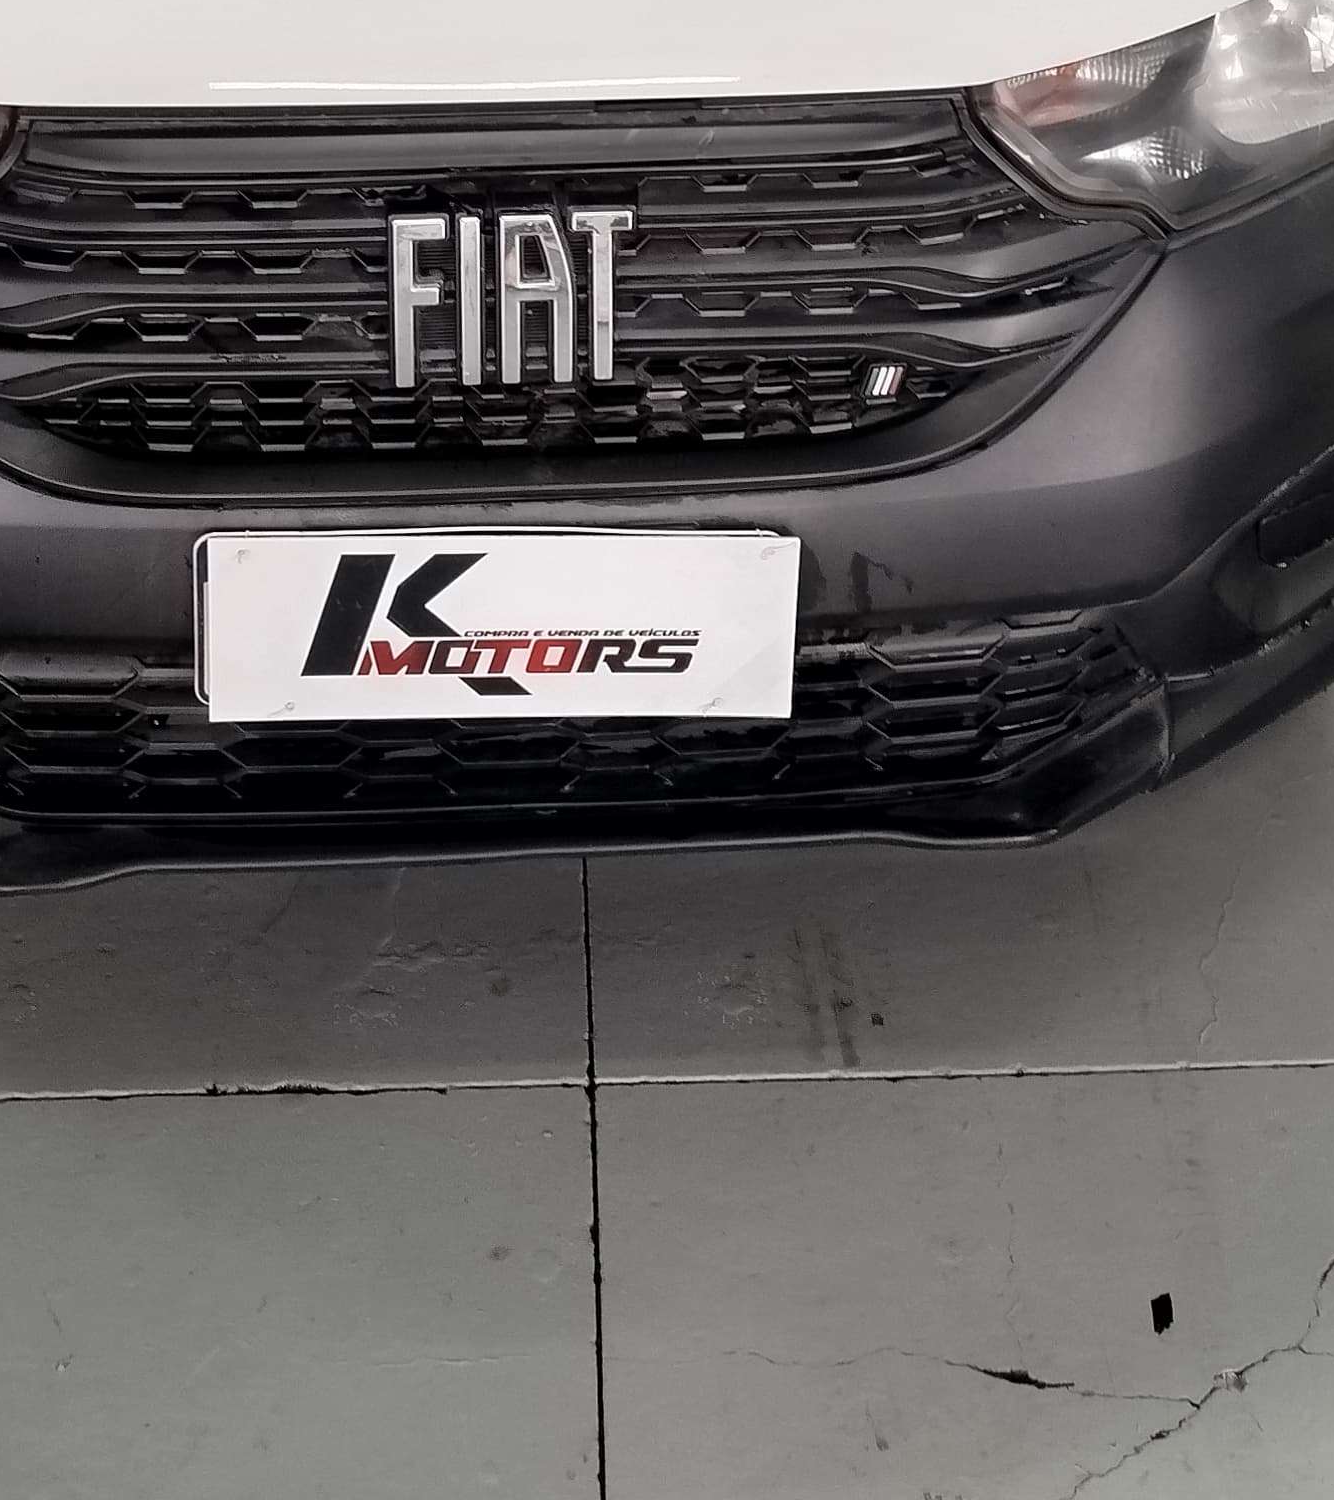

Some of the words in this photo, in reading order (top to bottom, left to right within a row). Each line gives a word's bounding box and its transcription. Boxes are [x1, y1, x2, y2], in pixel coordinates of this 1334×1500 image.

[390, 210, 634, 389] FIAT
[300, 552, 489, 677] K
[463, 629, 529, 638] COMPRA
[533, 629, 544, 638] E
[547, 629, 599, 637] VENDA
[603, 629, 624, 637] DE
[357, 637, 700, 676] MOTORS
